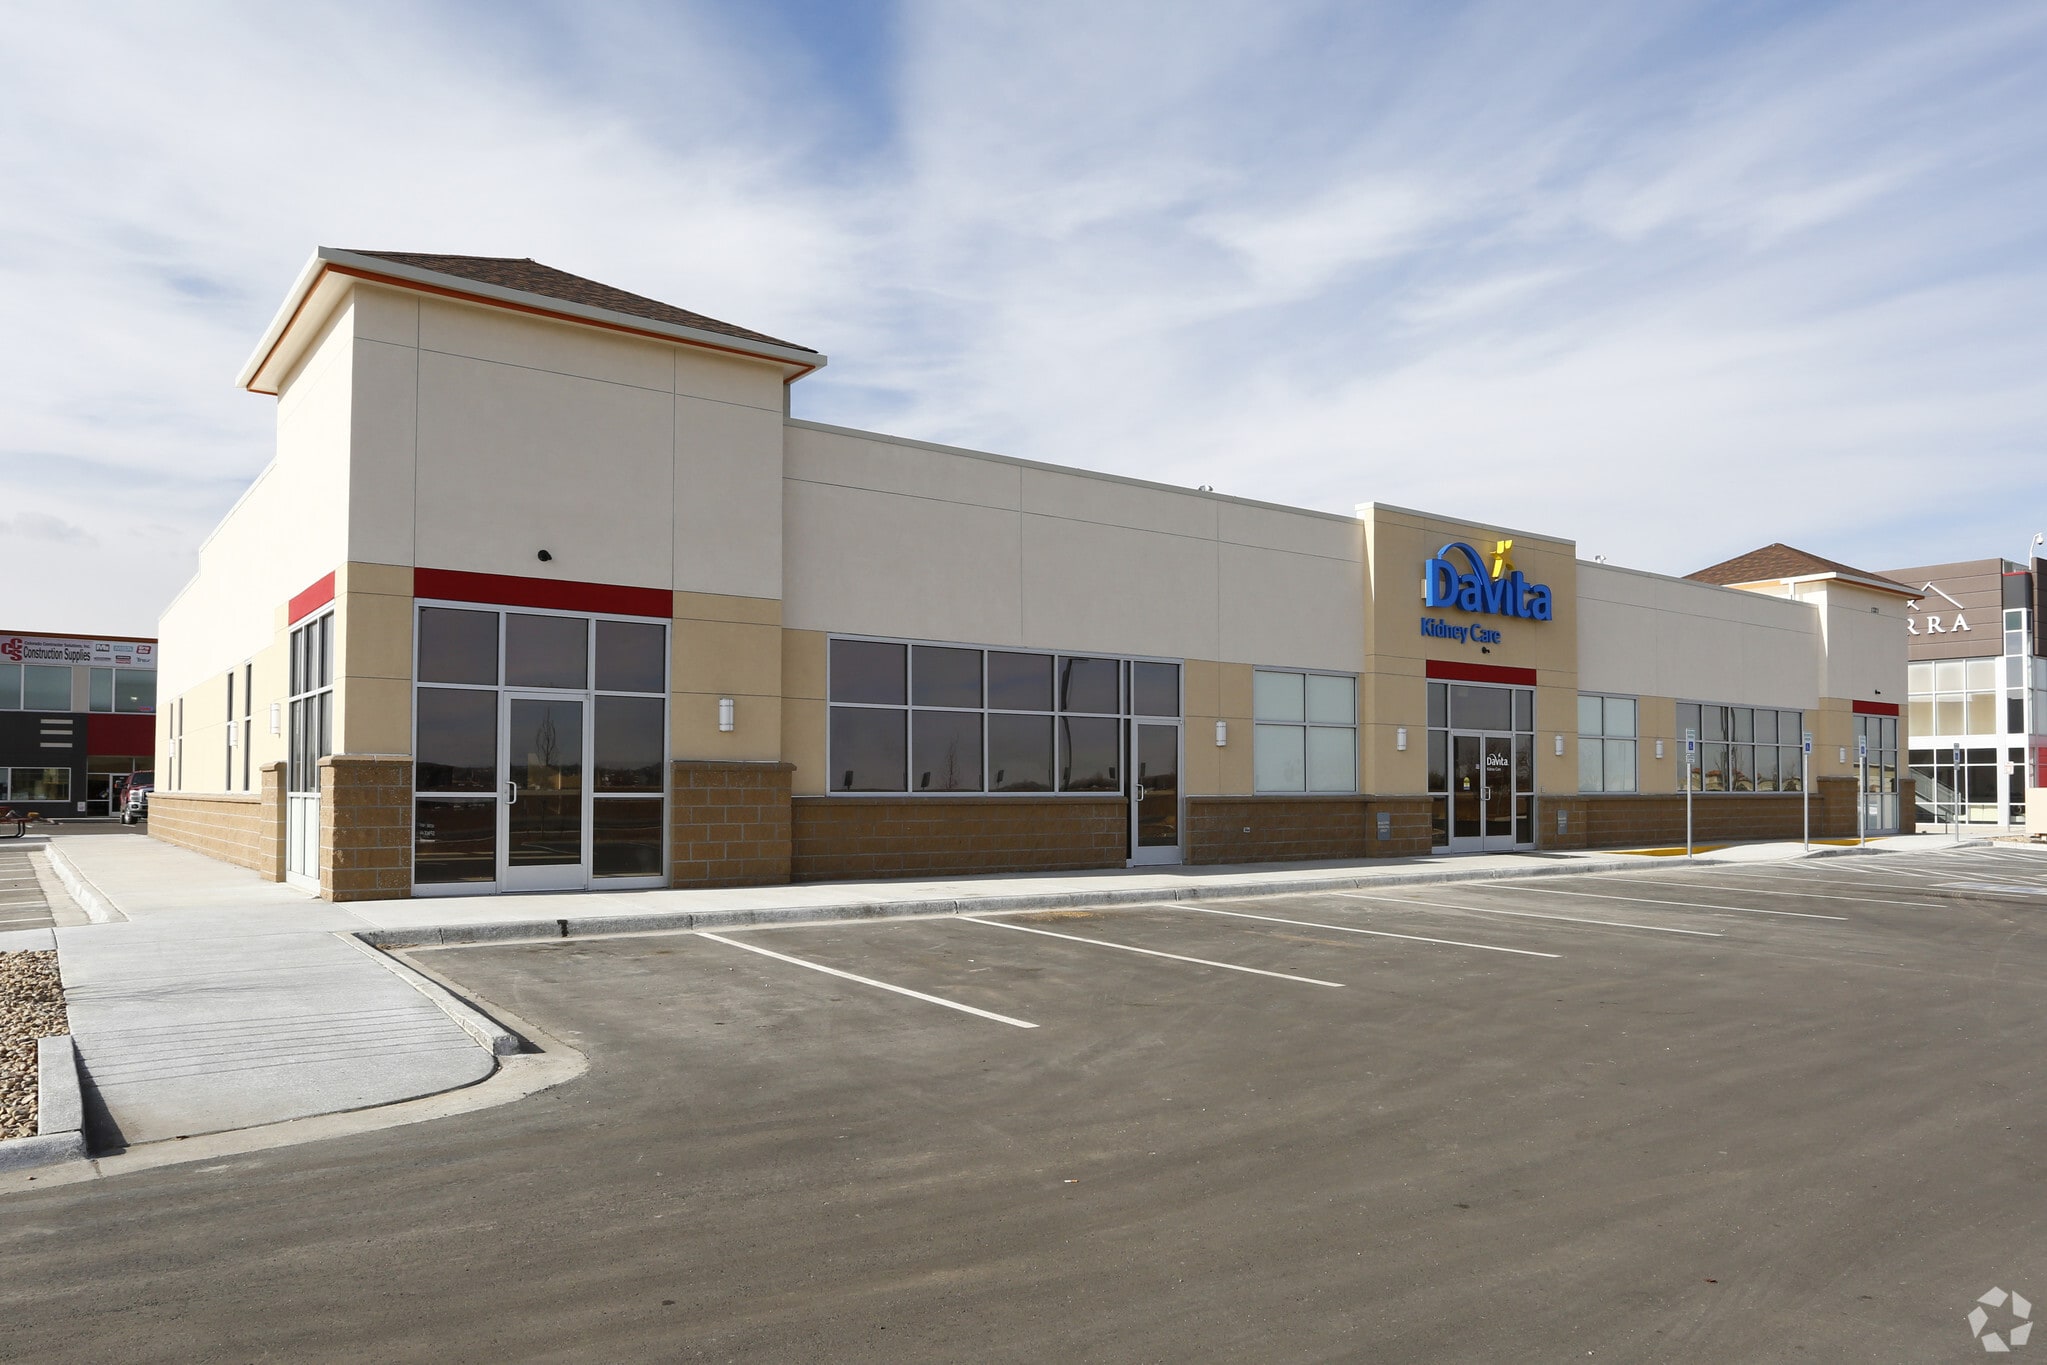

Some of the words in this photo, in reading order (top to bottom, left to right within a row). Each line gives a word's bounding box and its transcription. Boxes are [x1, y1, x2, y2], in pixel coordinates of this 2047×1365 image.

[1425, 541, 1552, 621] DaVita
[1421, 617, 1468, 644] Kidney
[1470, 624, 1501, 644] Care
[24, 646, 63, 659] Construction
[64, 648, 91, 663] Supplies
[1487, 753, 1509, 766] DaVita
